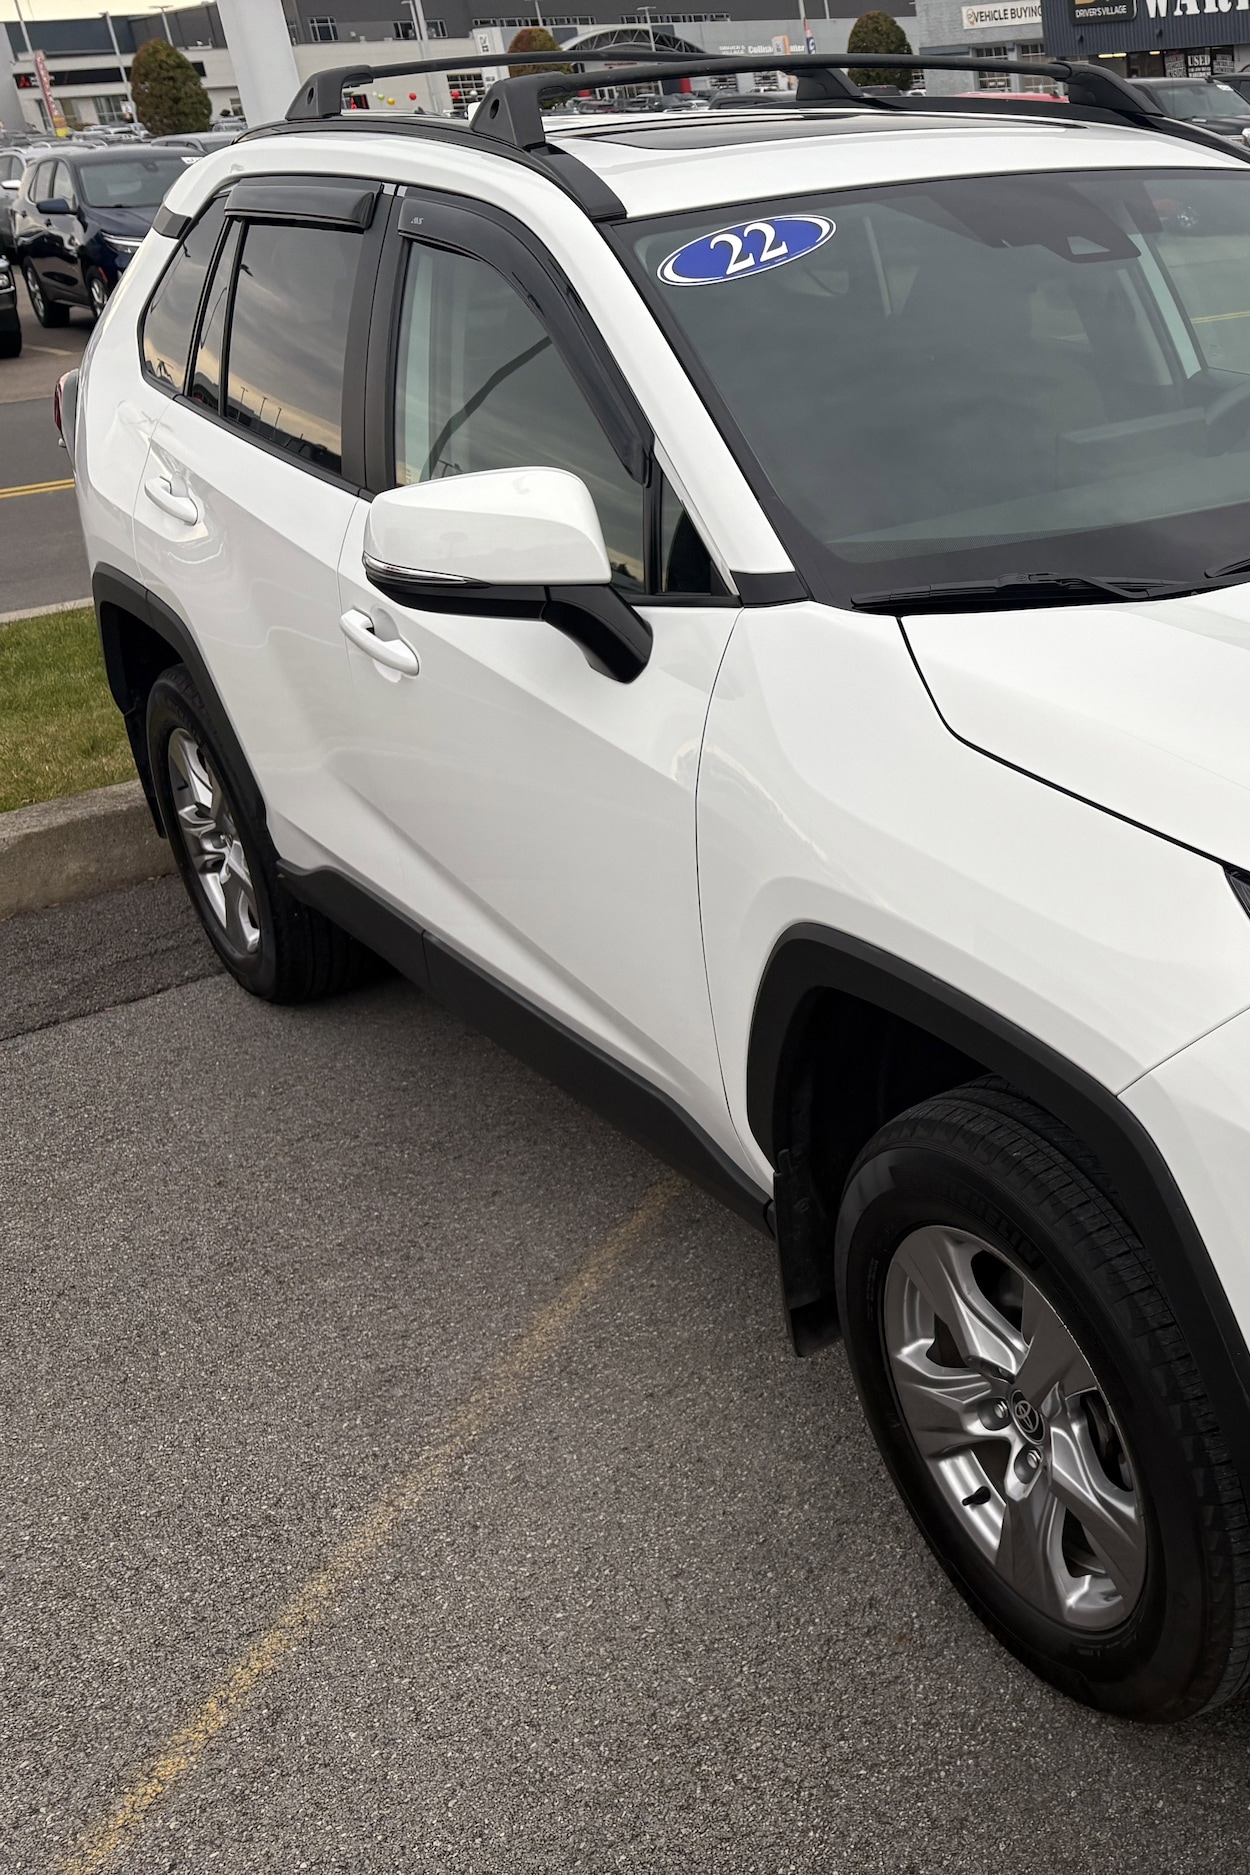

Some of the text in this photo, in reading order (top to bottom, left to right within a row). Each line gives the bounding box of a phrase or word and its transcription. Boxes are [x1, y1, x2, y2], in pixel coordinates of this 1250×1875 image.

[973, 9, 1008, 22] VEHICLE
[1102, 5, 1127, 15] VILLAGE
[1187, 55, 1211, 67] USED
[710, 222, 788, 275] 22
